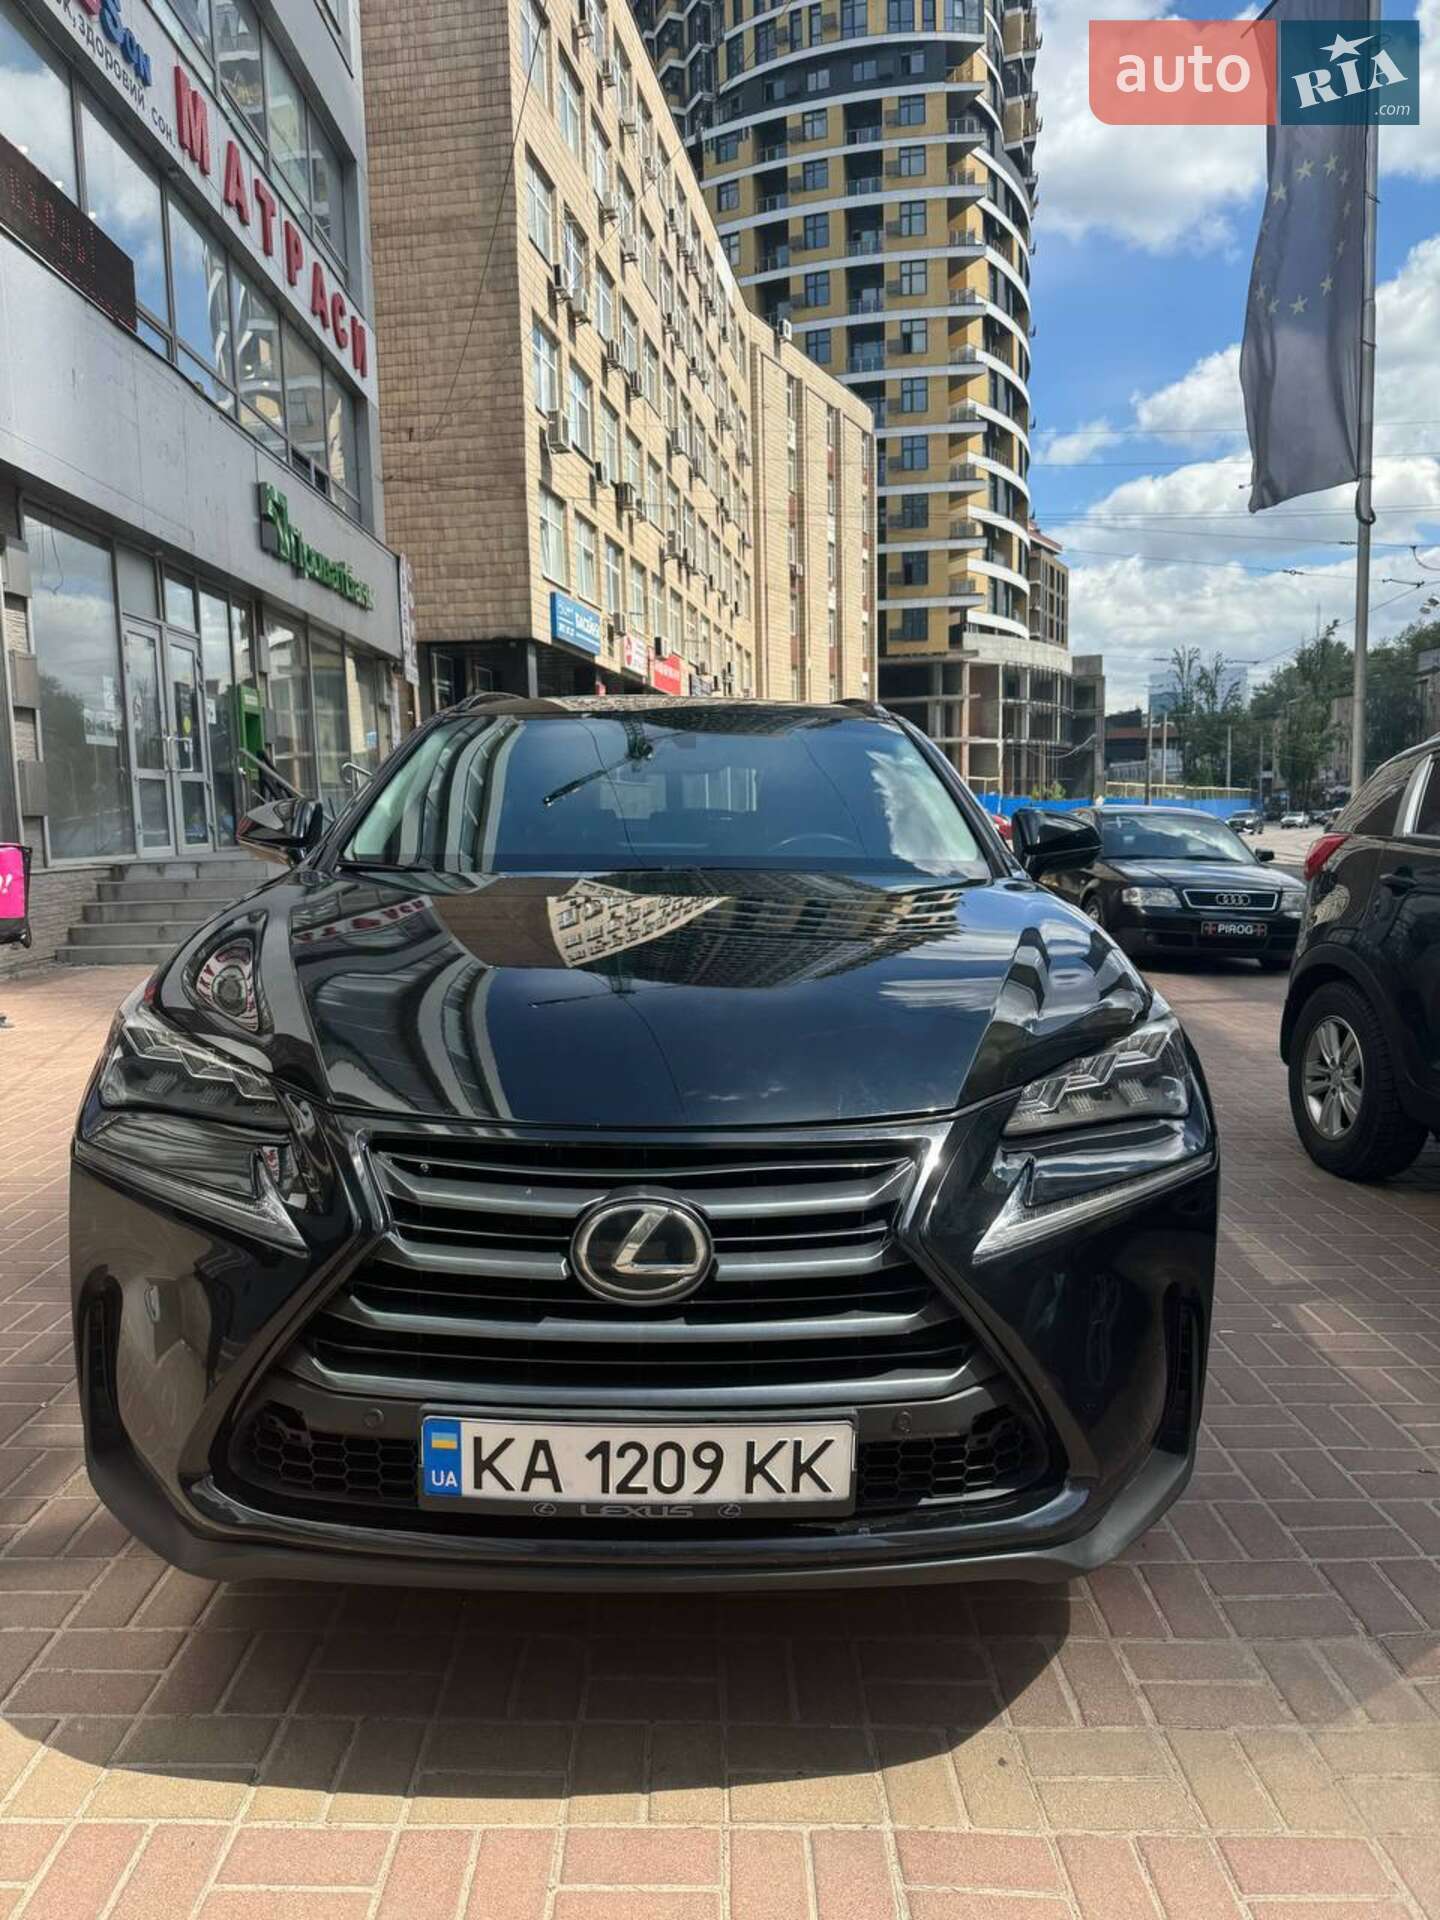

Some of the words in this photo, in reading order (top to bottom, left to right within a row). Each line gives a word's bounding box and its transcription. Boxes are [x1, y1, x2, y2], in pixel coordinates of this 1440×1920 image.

[174, 66, 367, 378] МАТРАСИ
[431, 1470, 458, 1488] UA
[472, 1436, 563, 1493] KA
[585, 1440, 724, 1495] 1209
[745, 1439, 835, 1494] KK
[580, 1504, 694, 1518] LEXUS
